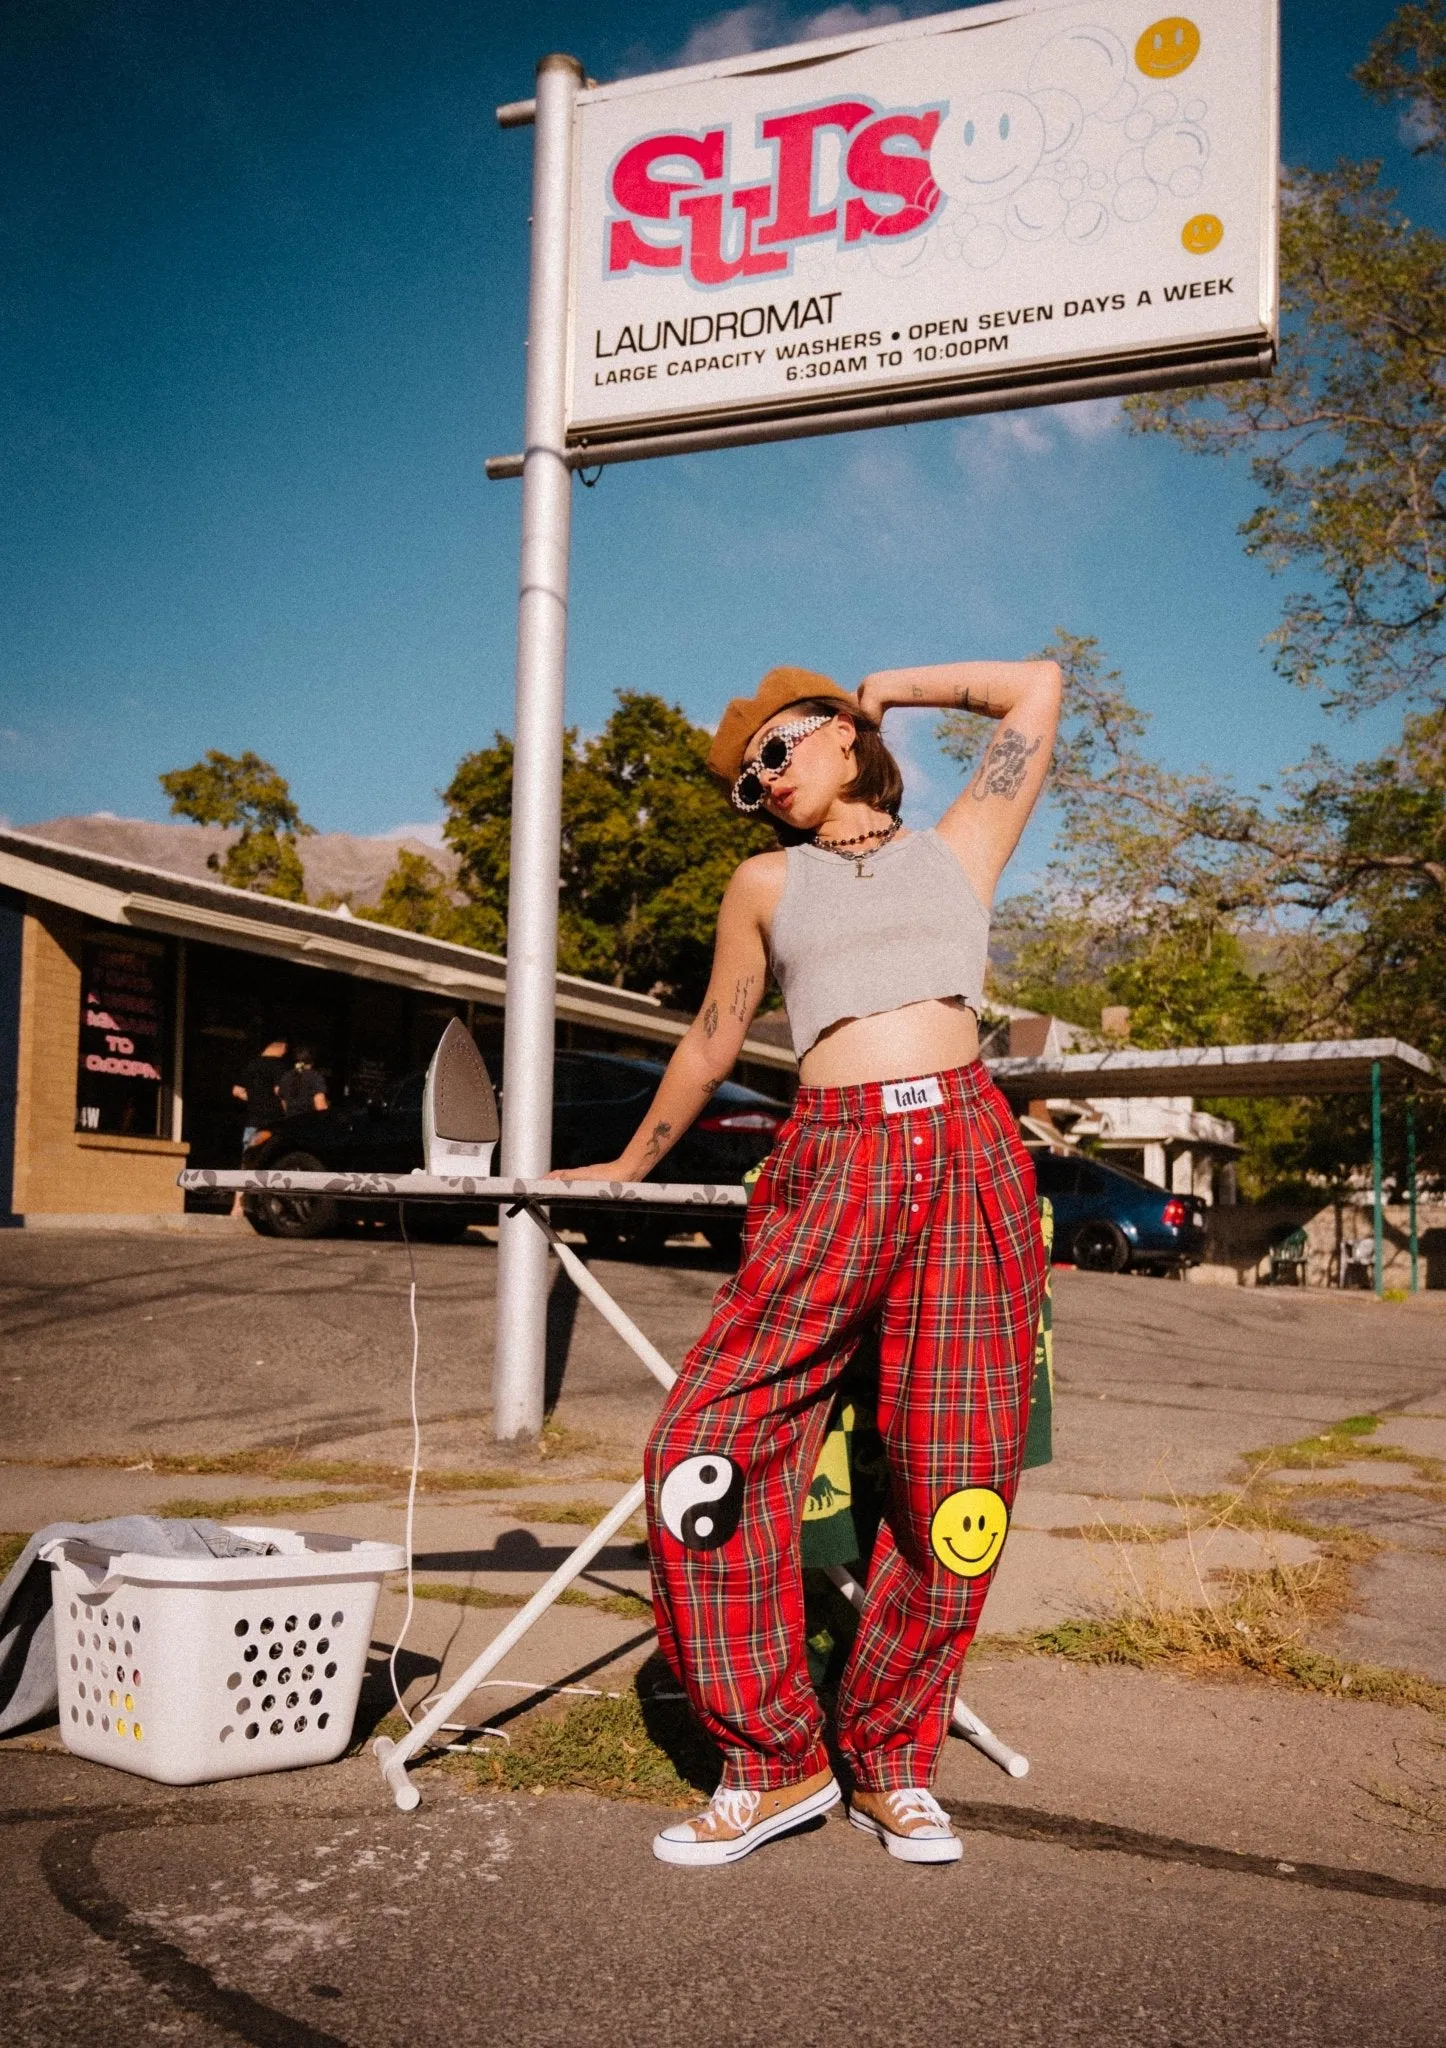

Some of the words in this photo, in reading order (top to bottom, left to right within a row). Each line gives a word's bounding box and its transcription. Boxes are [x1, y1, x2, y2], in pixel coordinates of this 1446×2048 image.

[594, 364, 658, 387] LARGE
[666, 348, 766, 377] CAPACITY
[775, 330, 882, 361] WASHERS
[908, 317, 968, 341] OPEN
[978, 304, 1053, 330] SEVEN
[1063, 293, 1126, 318] DAYS
[1136, 290, 1152, 308] A
[1163, 277, 1235, 303] WEEK
[595, 292, 842, 358] LAUNDROMAT
[786, 355, 868, 382] 6:30AM
[877, 350, 902, 369] TO
[913, 335, 1009, 363] 10:00PM
[105, 1034, 135, 1056] TO
[894, 1086, 928, 1108] lala
